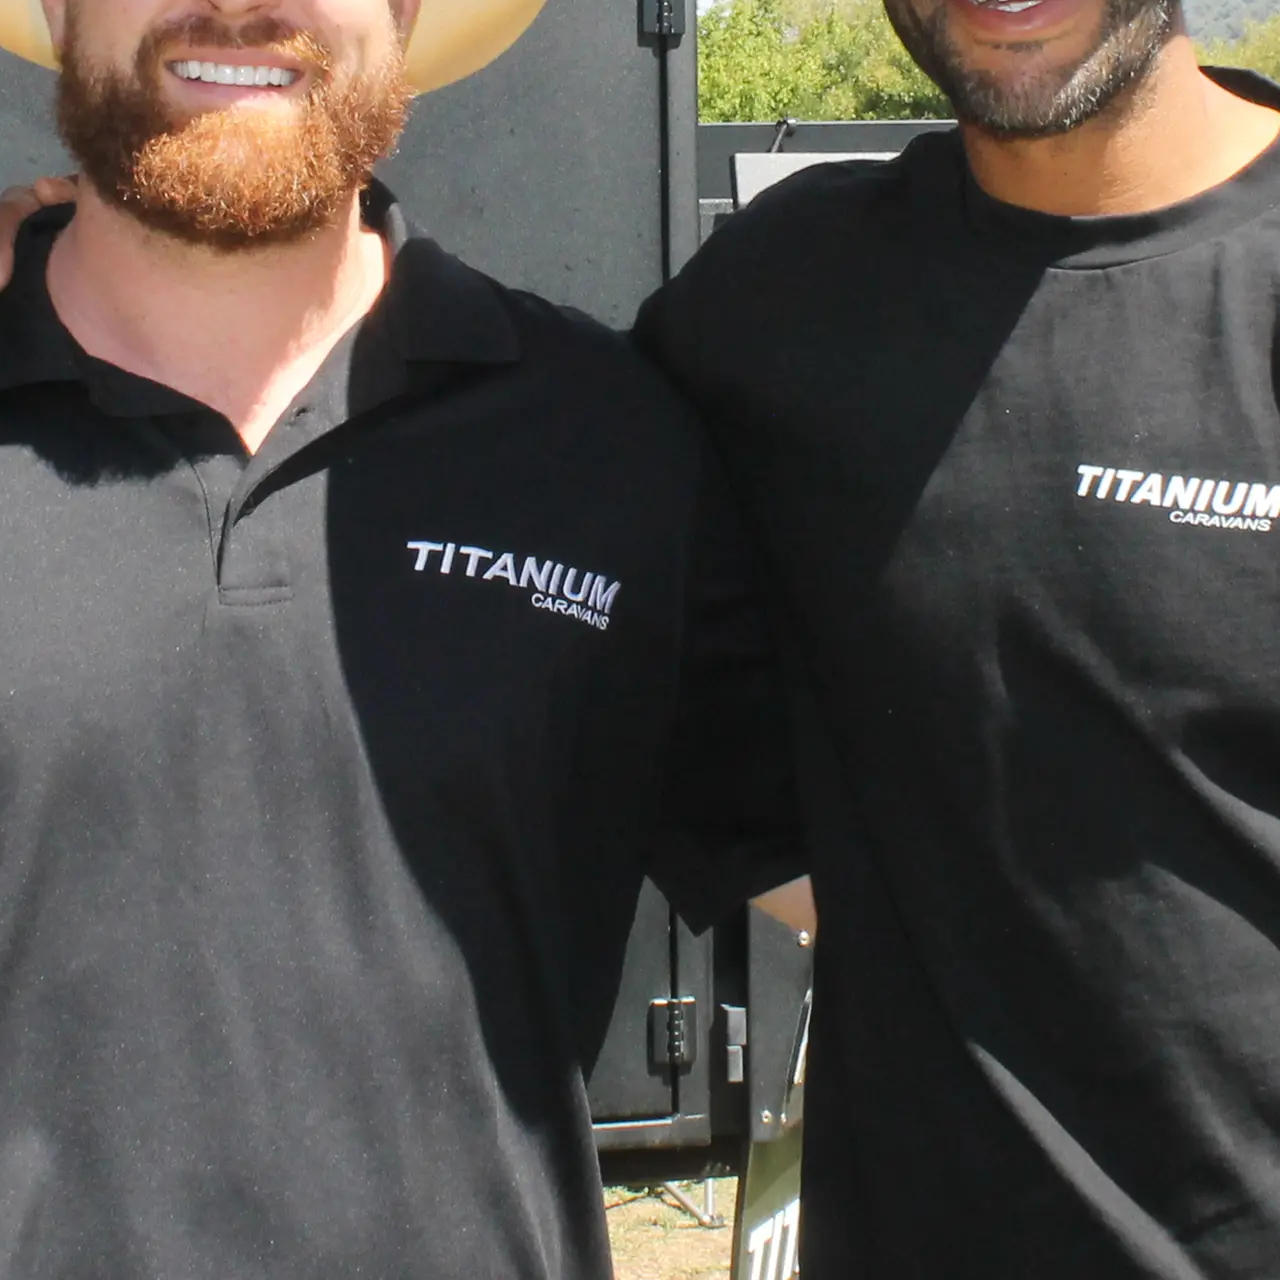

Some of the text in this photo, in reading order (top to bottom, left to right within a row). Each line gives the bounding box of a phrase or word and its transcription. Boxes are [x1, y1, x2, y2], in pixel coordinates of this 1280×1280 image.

[1168, 510, 1272, 532] CARAVANS
[406, 541, 621, 613] TITANIUM
[531, 592, 610, 631] CARAVANS
